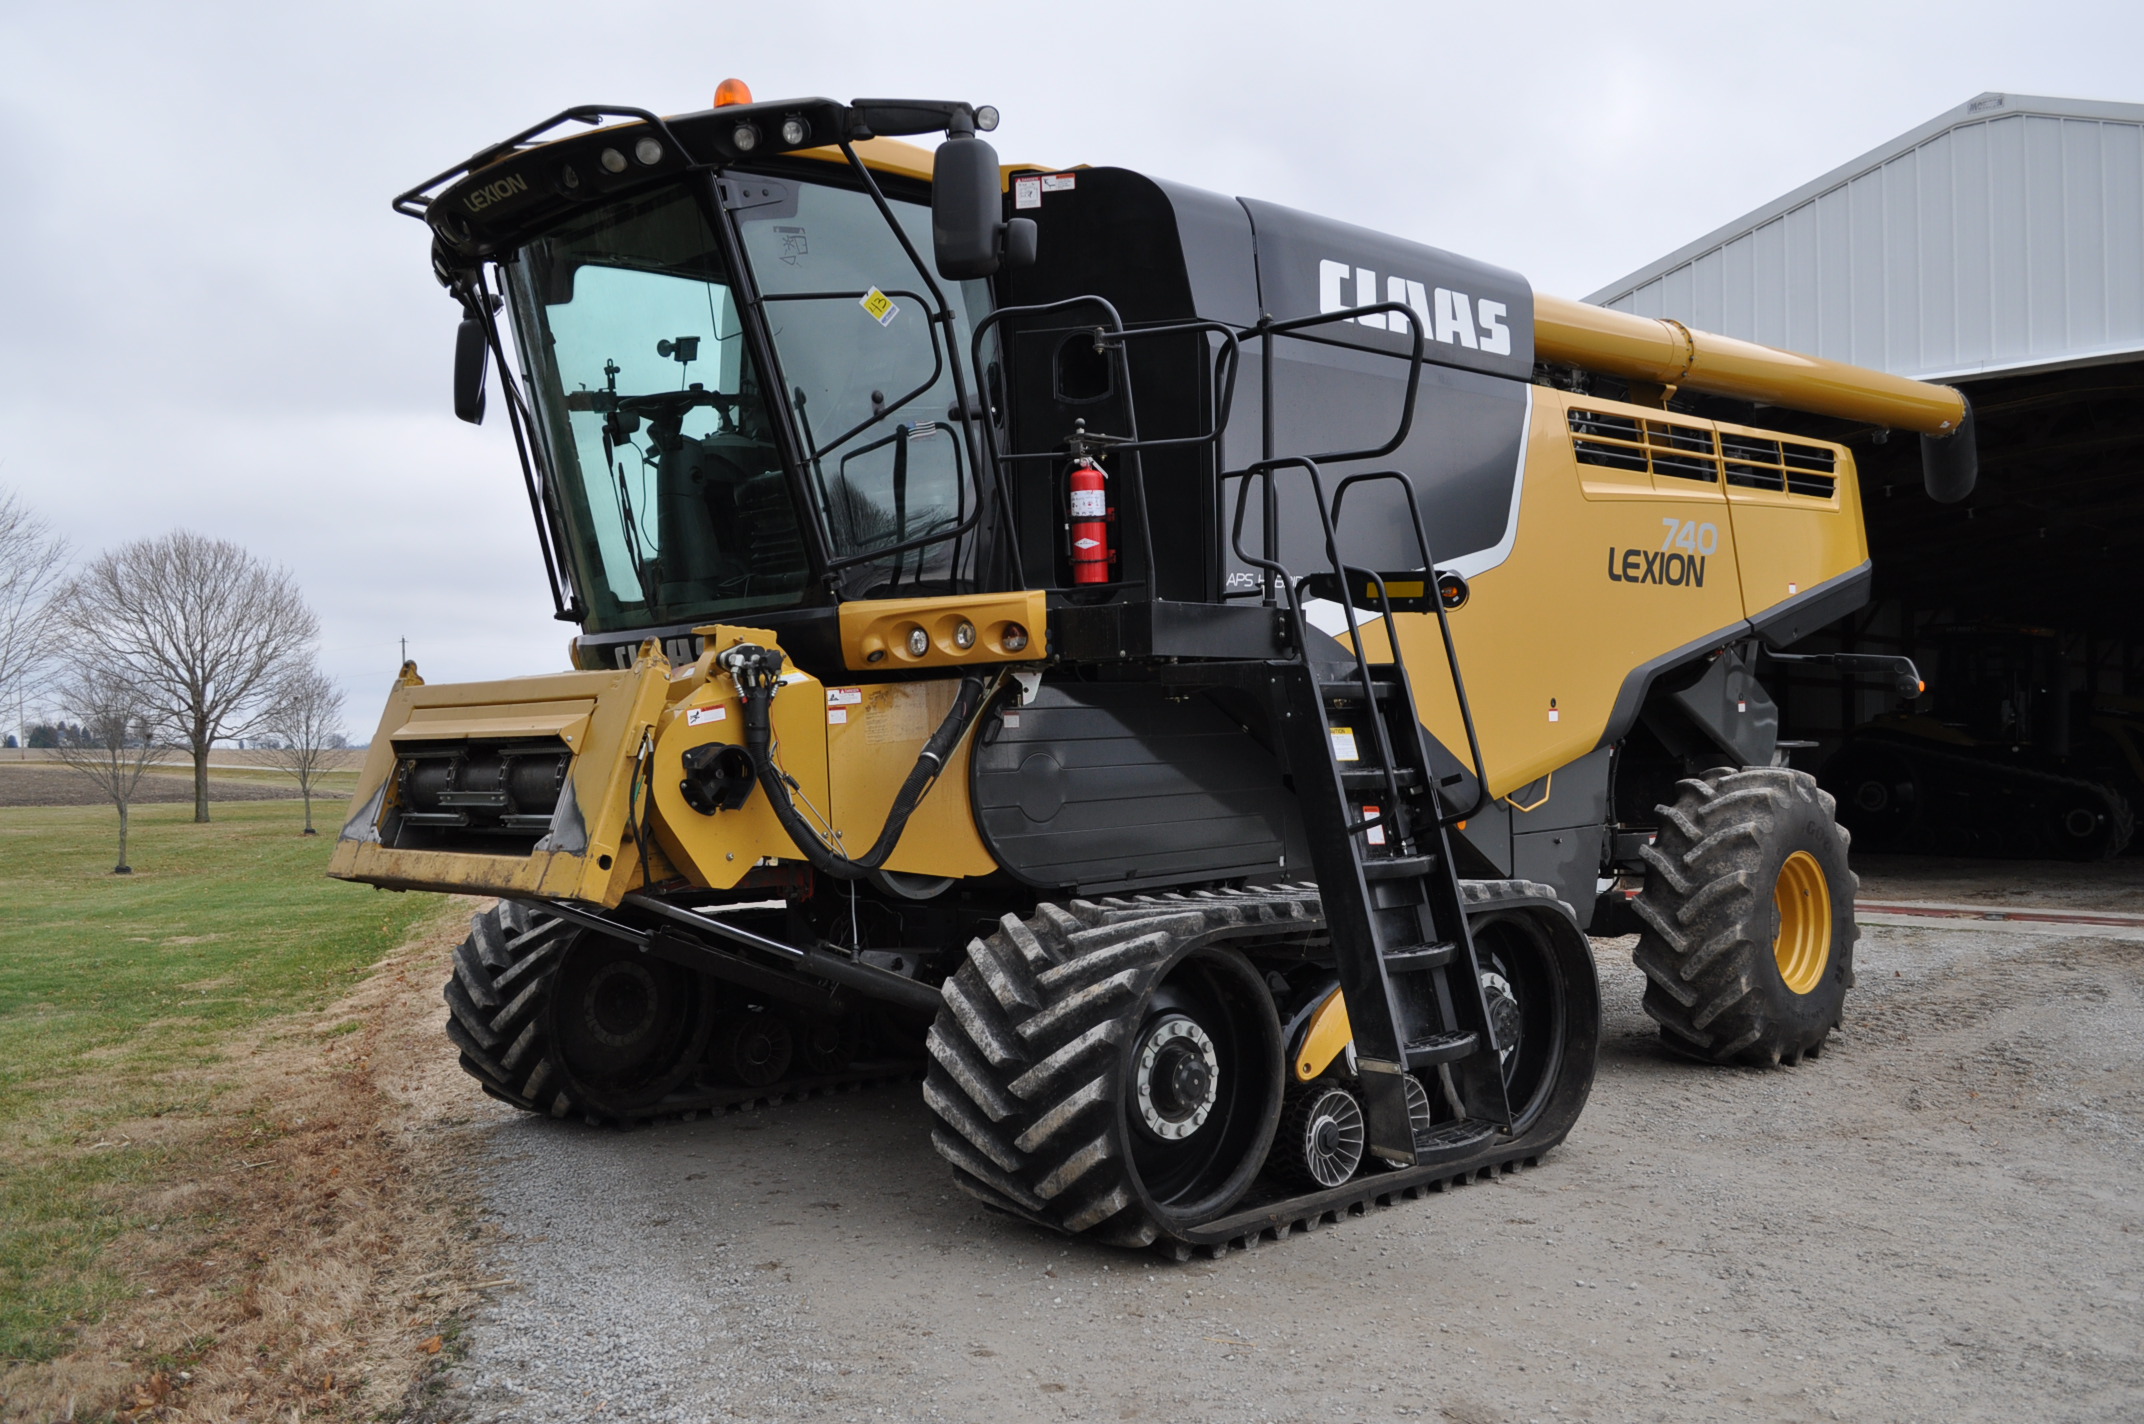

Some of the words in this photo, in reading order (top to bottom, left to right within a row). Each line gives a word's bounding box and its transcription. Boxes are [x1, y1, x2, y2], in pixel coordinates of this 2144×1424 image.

[463, 173, 528, 212] LEXION
[869, 297, 887, 313] 43
[1319, 258, 1511, 356] CLAAS
[1661, 517, 1718, 556] 740
[1226, 572, 1254, 587] APS
[1608, 547, 1706, 588] LEXION
